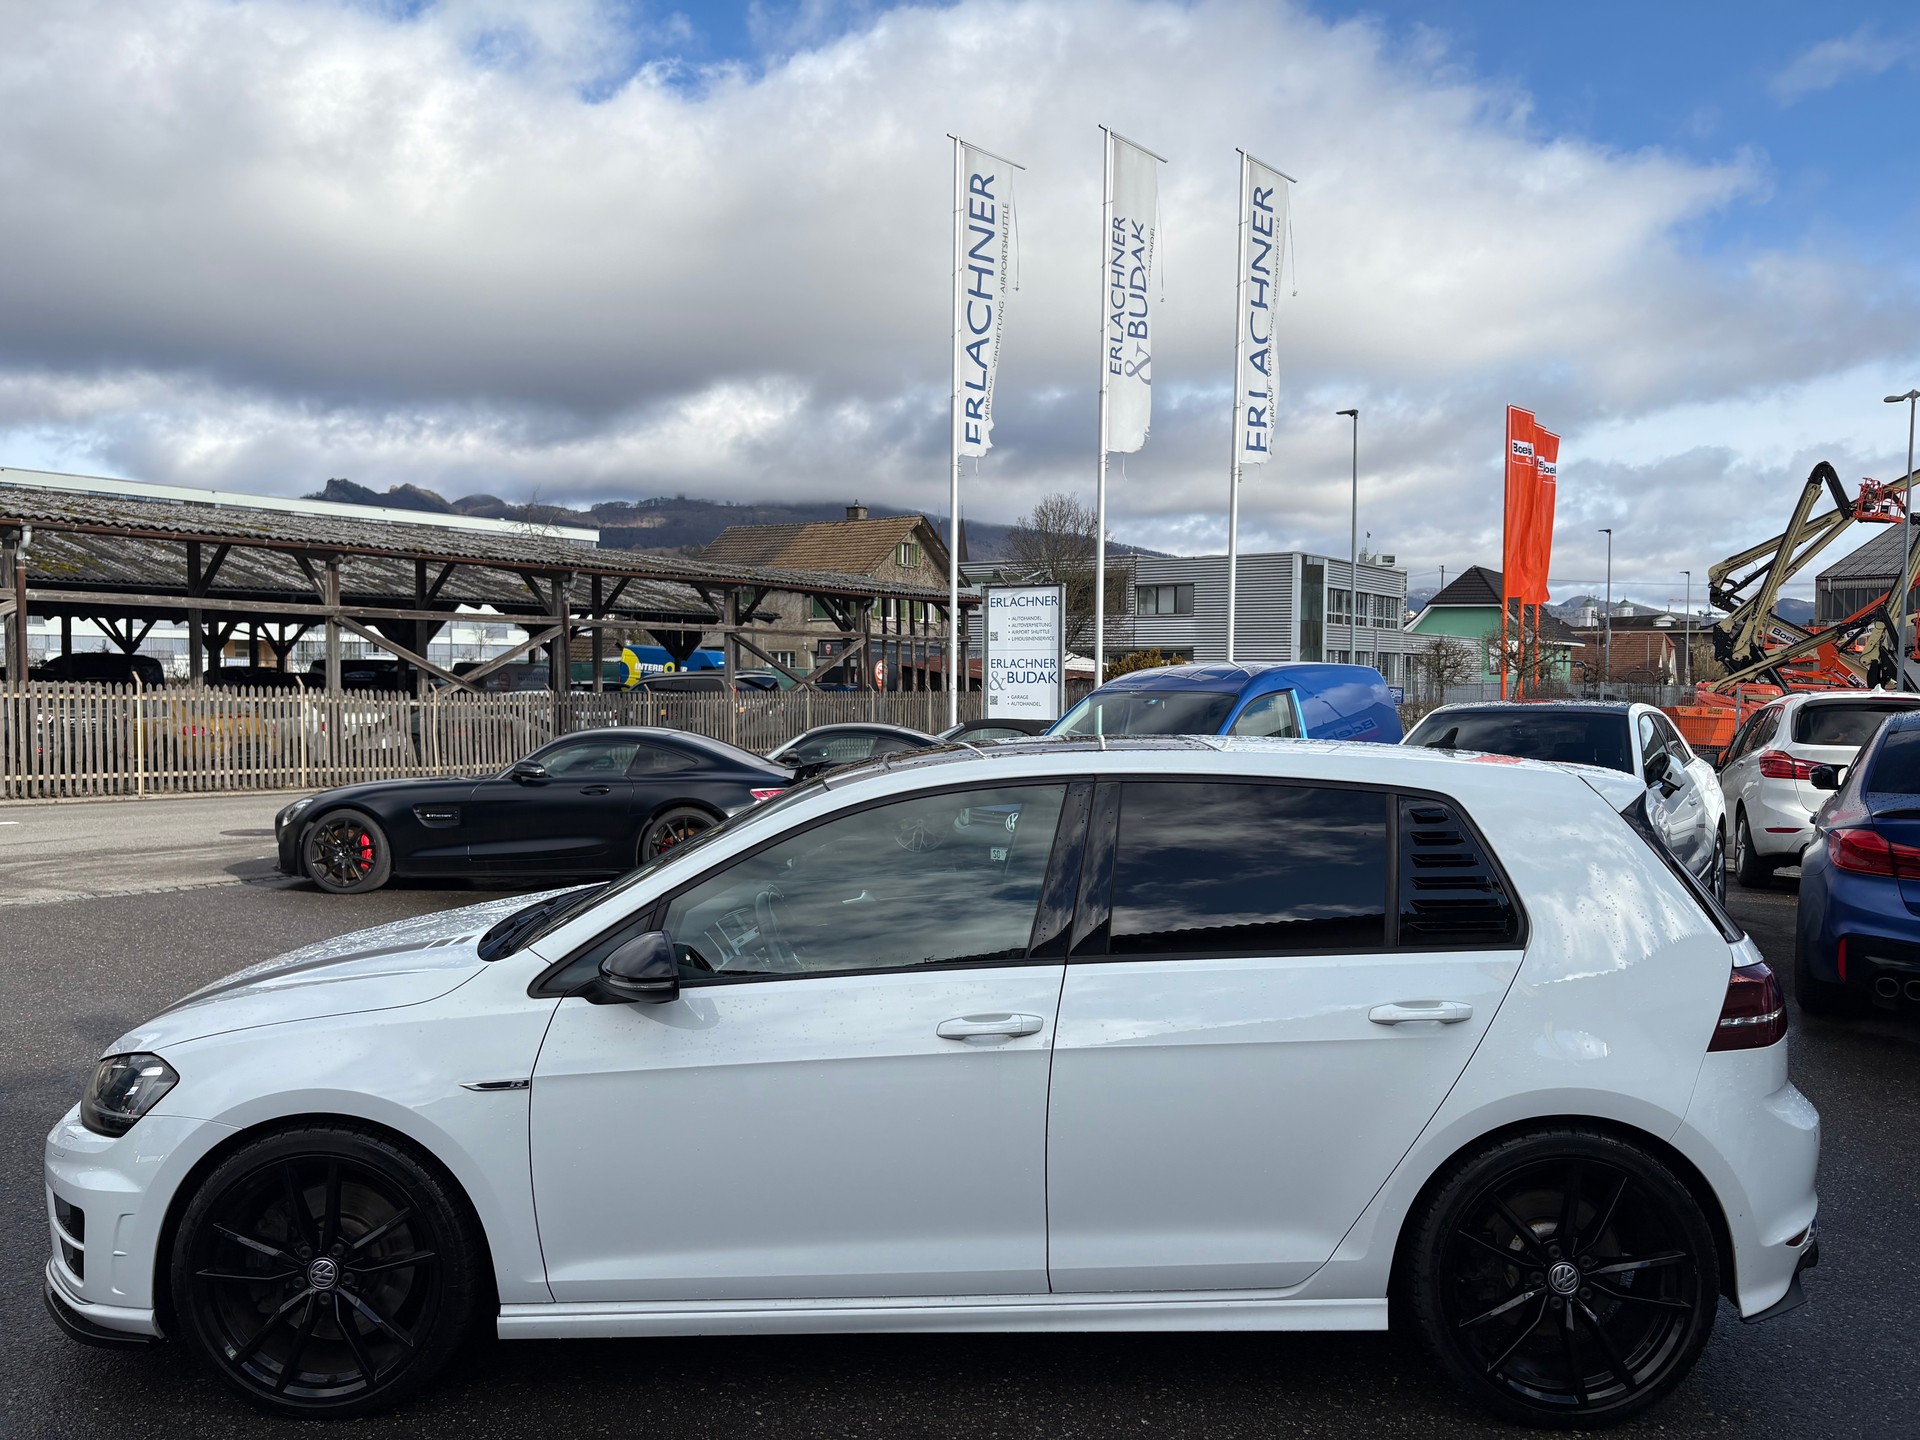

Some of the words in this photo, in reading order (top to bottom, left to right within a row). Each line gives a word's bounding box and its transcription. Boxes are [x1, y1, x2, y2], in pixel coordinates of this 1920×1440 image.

[1109, 217, 1126, 375] ERLACHNER
[1127, 219, 1148, 340] BUDAK
[965, 173, 995, 445] ERLACHNER
[985, 375, 993, 422] VERKAUF
[992, 300, 1005, 368] VERMIETUNG
[1000, 202, 1009, 294] AIRPORTSHUTTLE
[1125, 341, 1151, 386] &
[1513, 442, 1532, 455] Boes
[990, 595, 1058, 608] ERLACHNER
[989, 670, 1006, 691] &
[1007, 671, 1057, 684] BUDAK
[990, 658, 1057, 668] ERLACHNER
